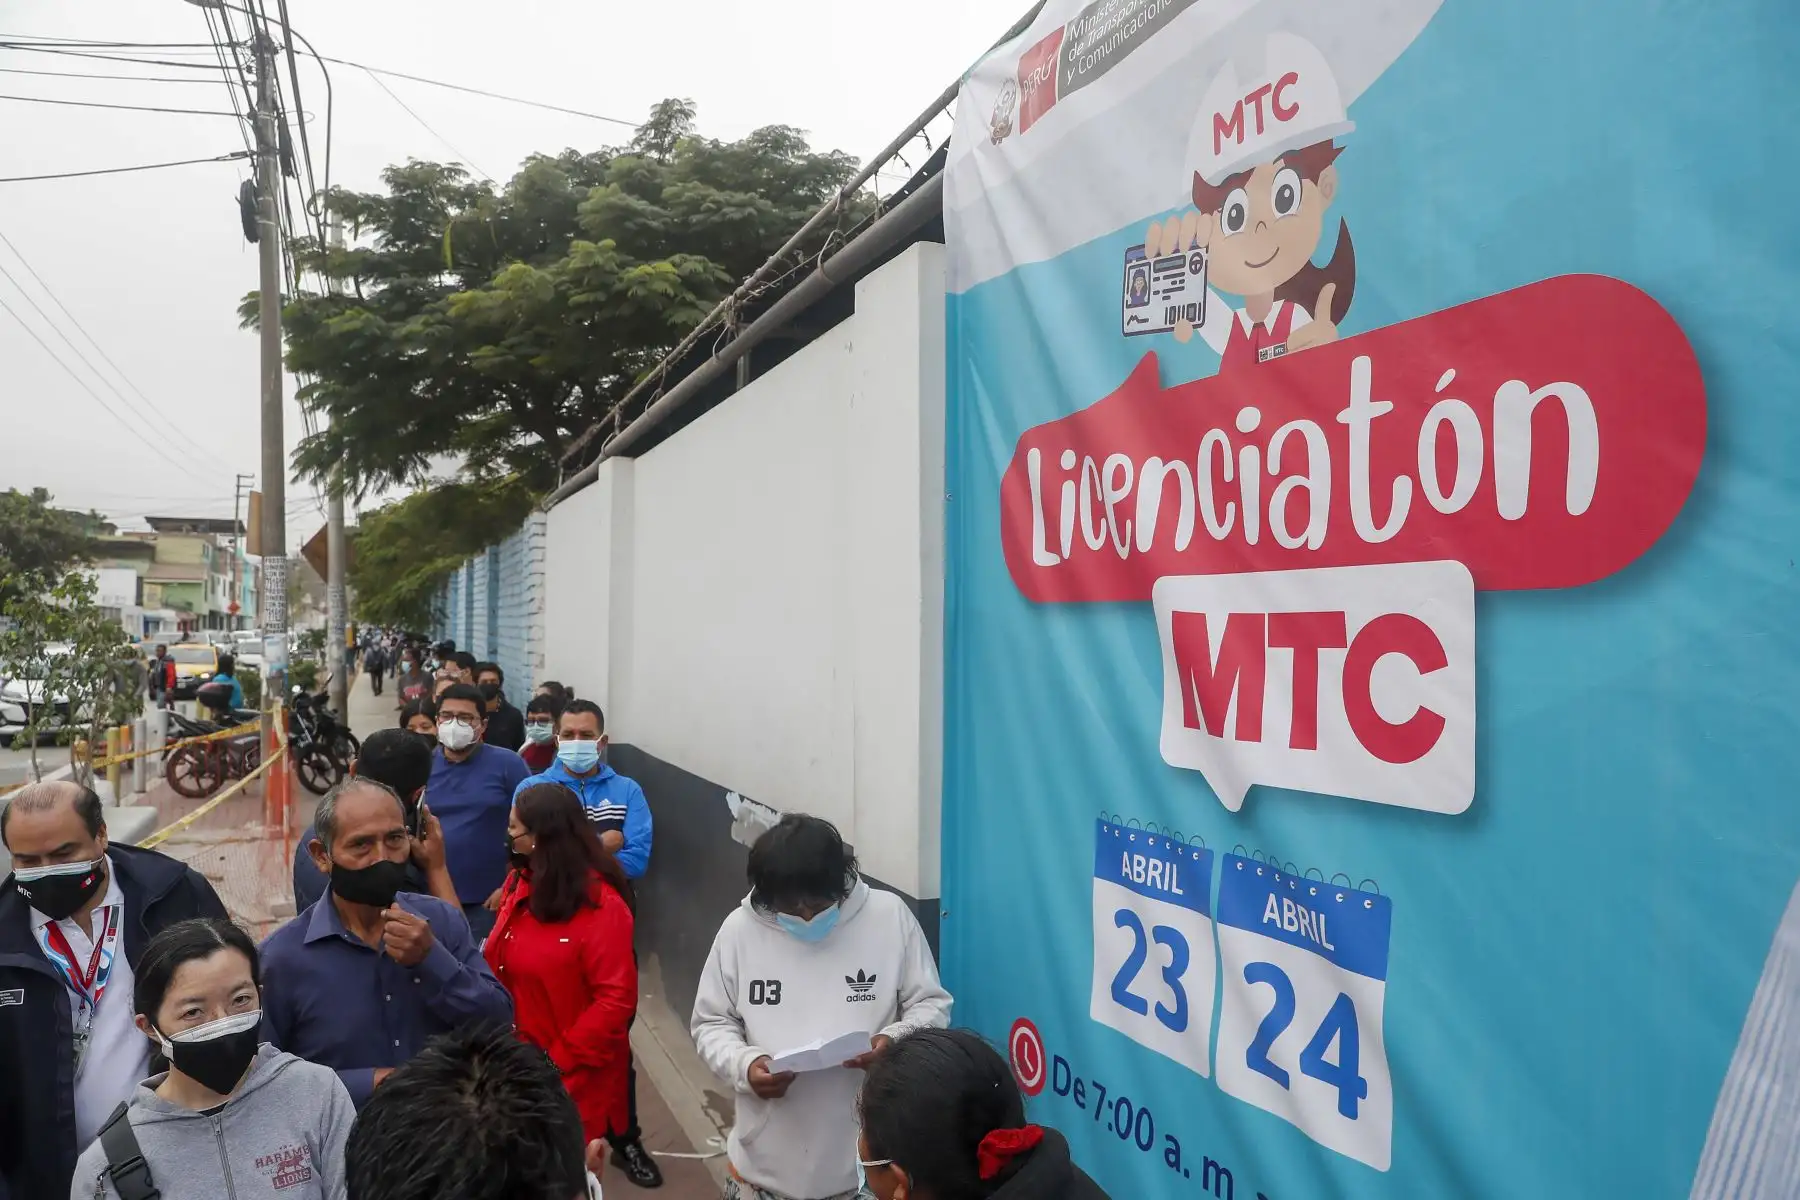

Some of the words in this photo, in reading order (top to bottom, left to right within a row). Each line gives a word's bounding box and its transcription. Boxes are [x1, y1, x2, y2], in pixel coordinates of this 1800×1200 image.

[1067, 67, 1076, 86] y
[1069, 42, 1084, 62] de
[1023, 53, 1055, 102] PERÚ
[1213, 71, 1300, 156] MTC
[1027, 355, 1599, 567] Licenciatón
[1171, 610, 1449, 764] MTC
[17, 884, 32, 899] MTC
[1121, 851, 1184, 896] ABRIL
[1262, 892, 1335, 951] ABRIL
[749, 979, 782, 1006] 03
[1111, 908, 1190, 1033] 23
[846, 992, 876, 1003] adidas
[1243, 961, 1368, 1121] 24
[1052, 1054, 1087, 1110] De
[1092, 1080, 1154, 1152] 7:00
[276, 1169, 310, 1187] LIONS
